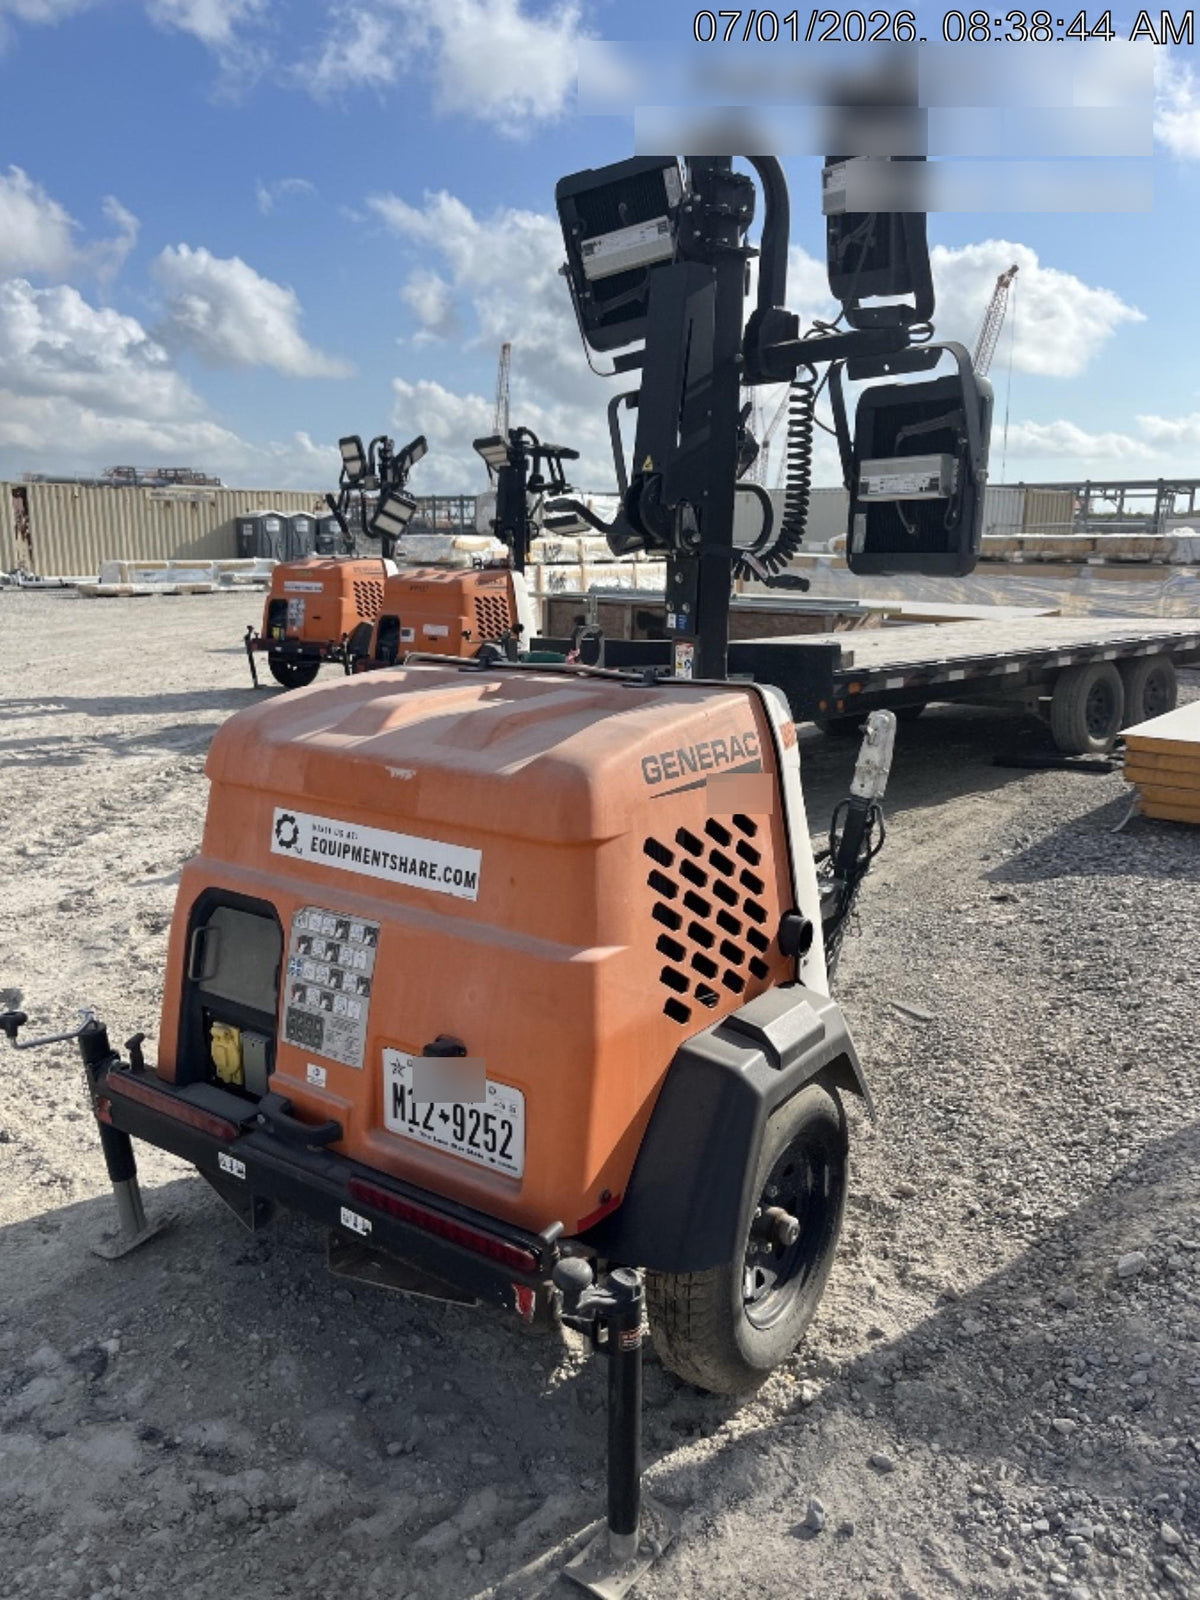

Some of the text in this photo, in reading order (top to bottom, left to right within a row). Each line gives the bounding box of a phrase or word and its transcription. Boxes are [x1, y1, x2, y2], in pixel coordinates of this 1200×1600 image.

[641, 732, 760, 785] GENERAC
[310, 836, 477, 889] EQUIPMENTSHARE.COM
[452, 1103, 513, 1160] 9252
